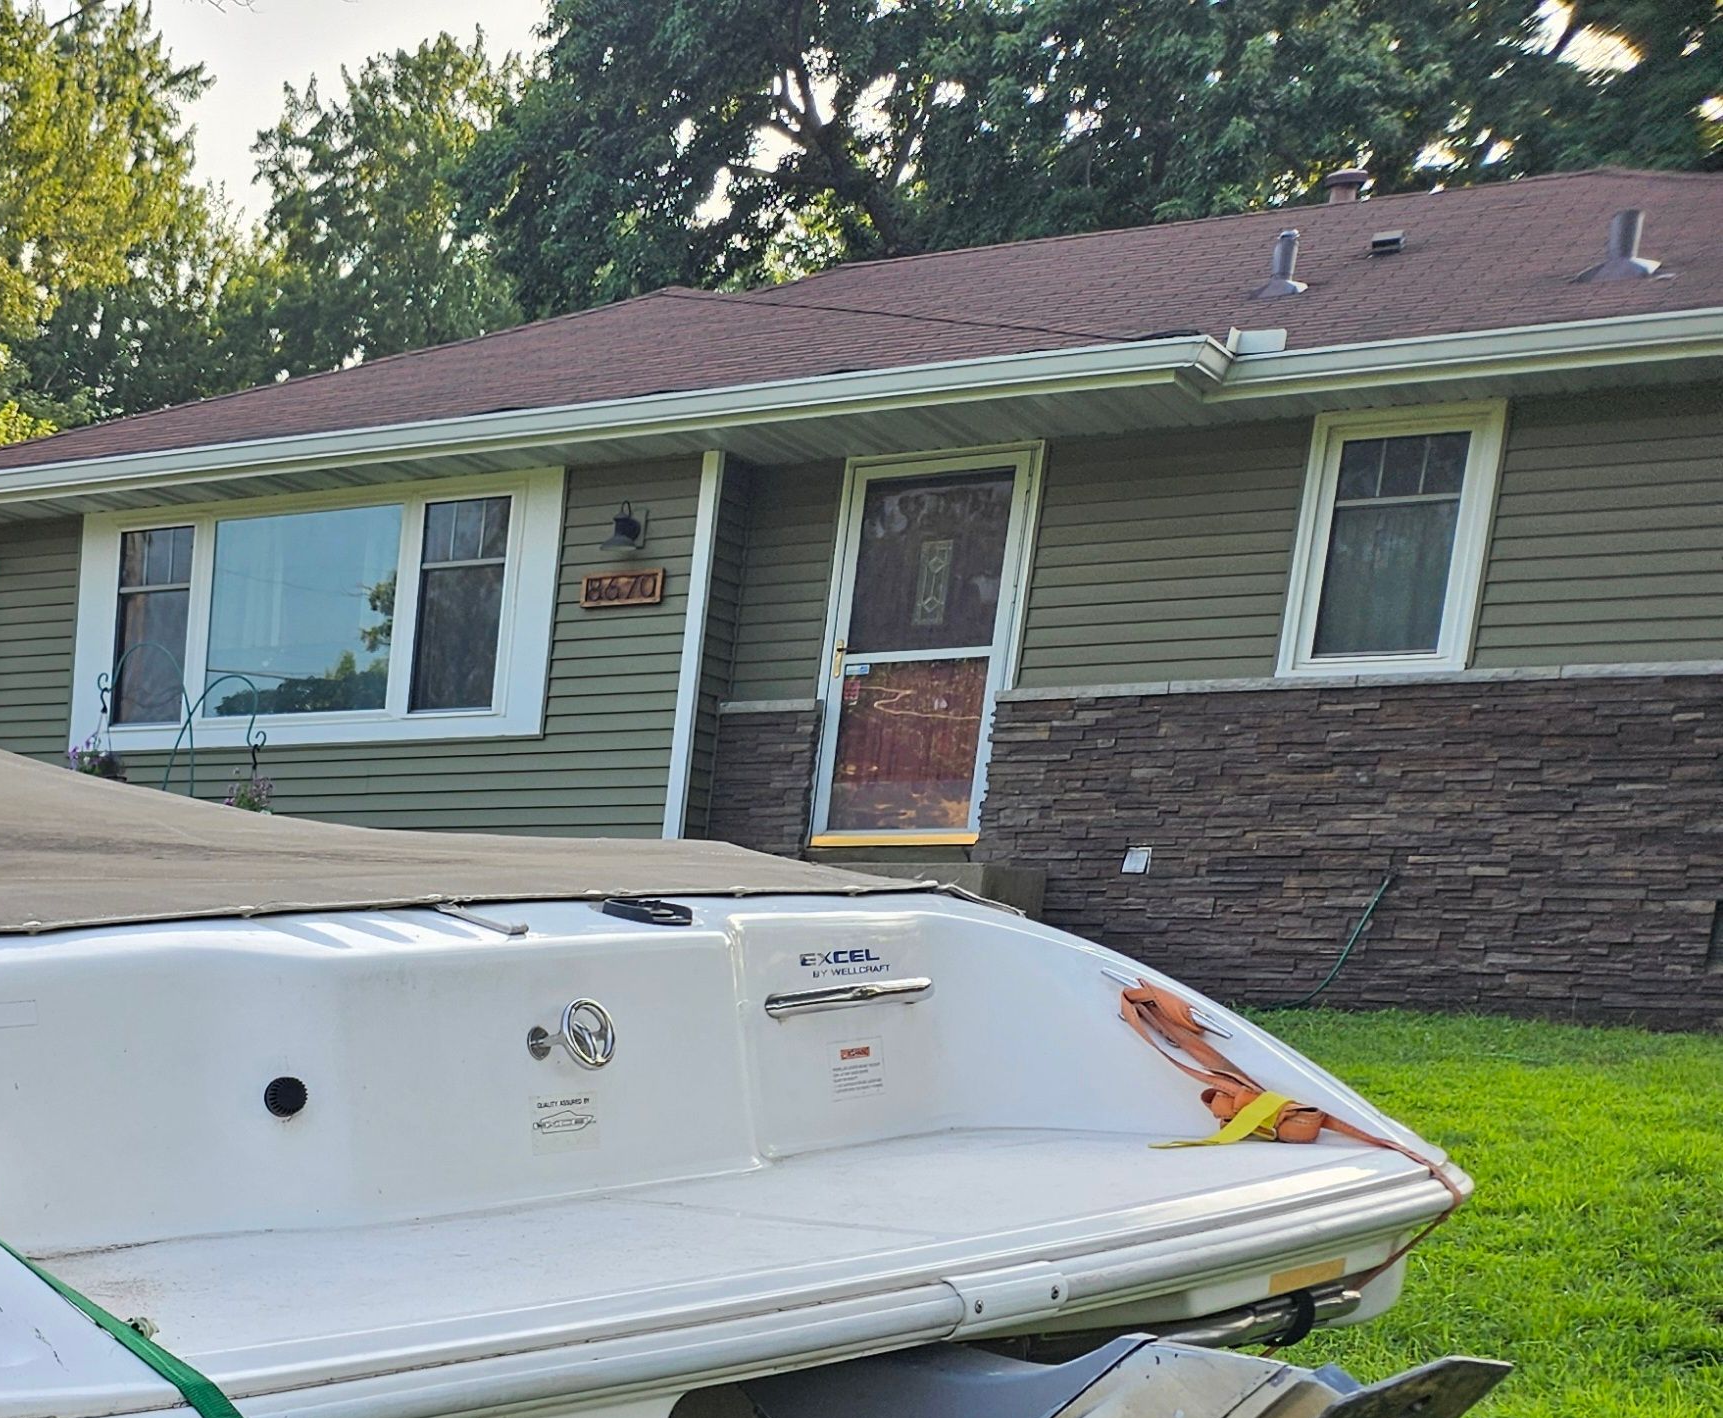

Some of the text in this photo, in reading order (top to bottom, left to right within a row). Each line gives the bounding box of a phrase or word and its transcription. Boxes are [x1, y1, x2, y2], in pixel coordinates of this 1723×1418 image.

[588, 575, 657, 601] 8670
[799, 949, 880, 966] EXCEL
[813, 965, 890, 978] BY WELLCRAFT
